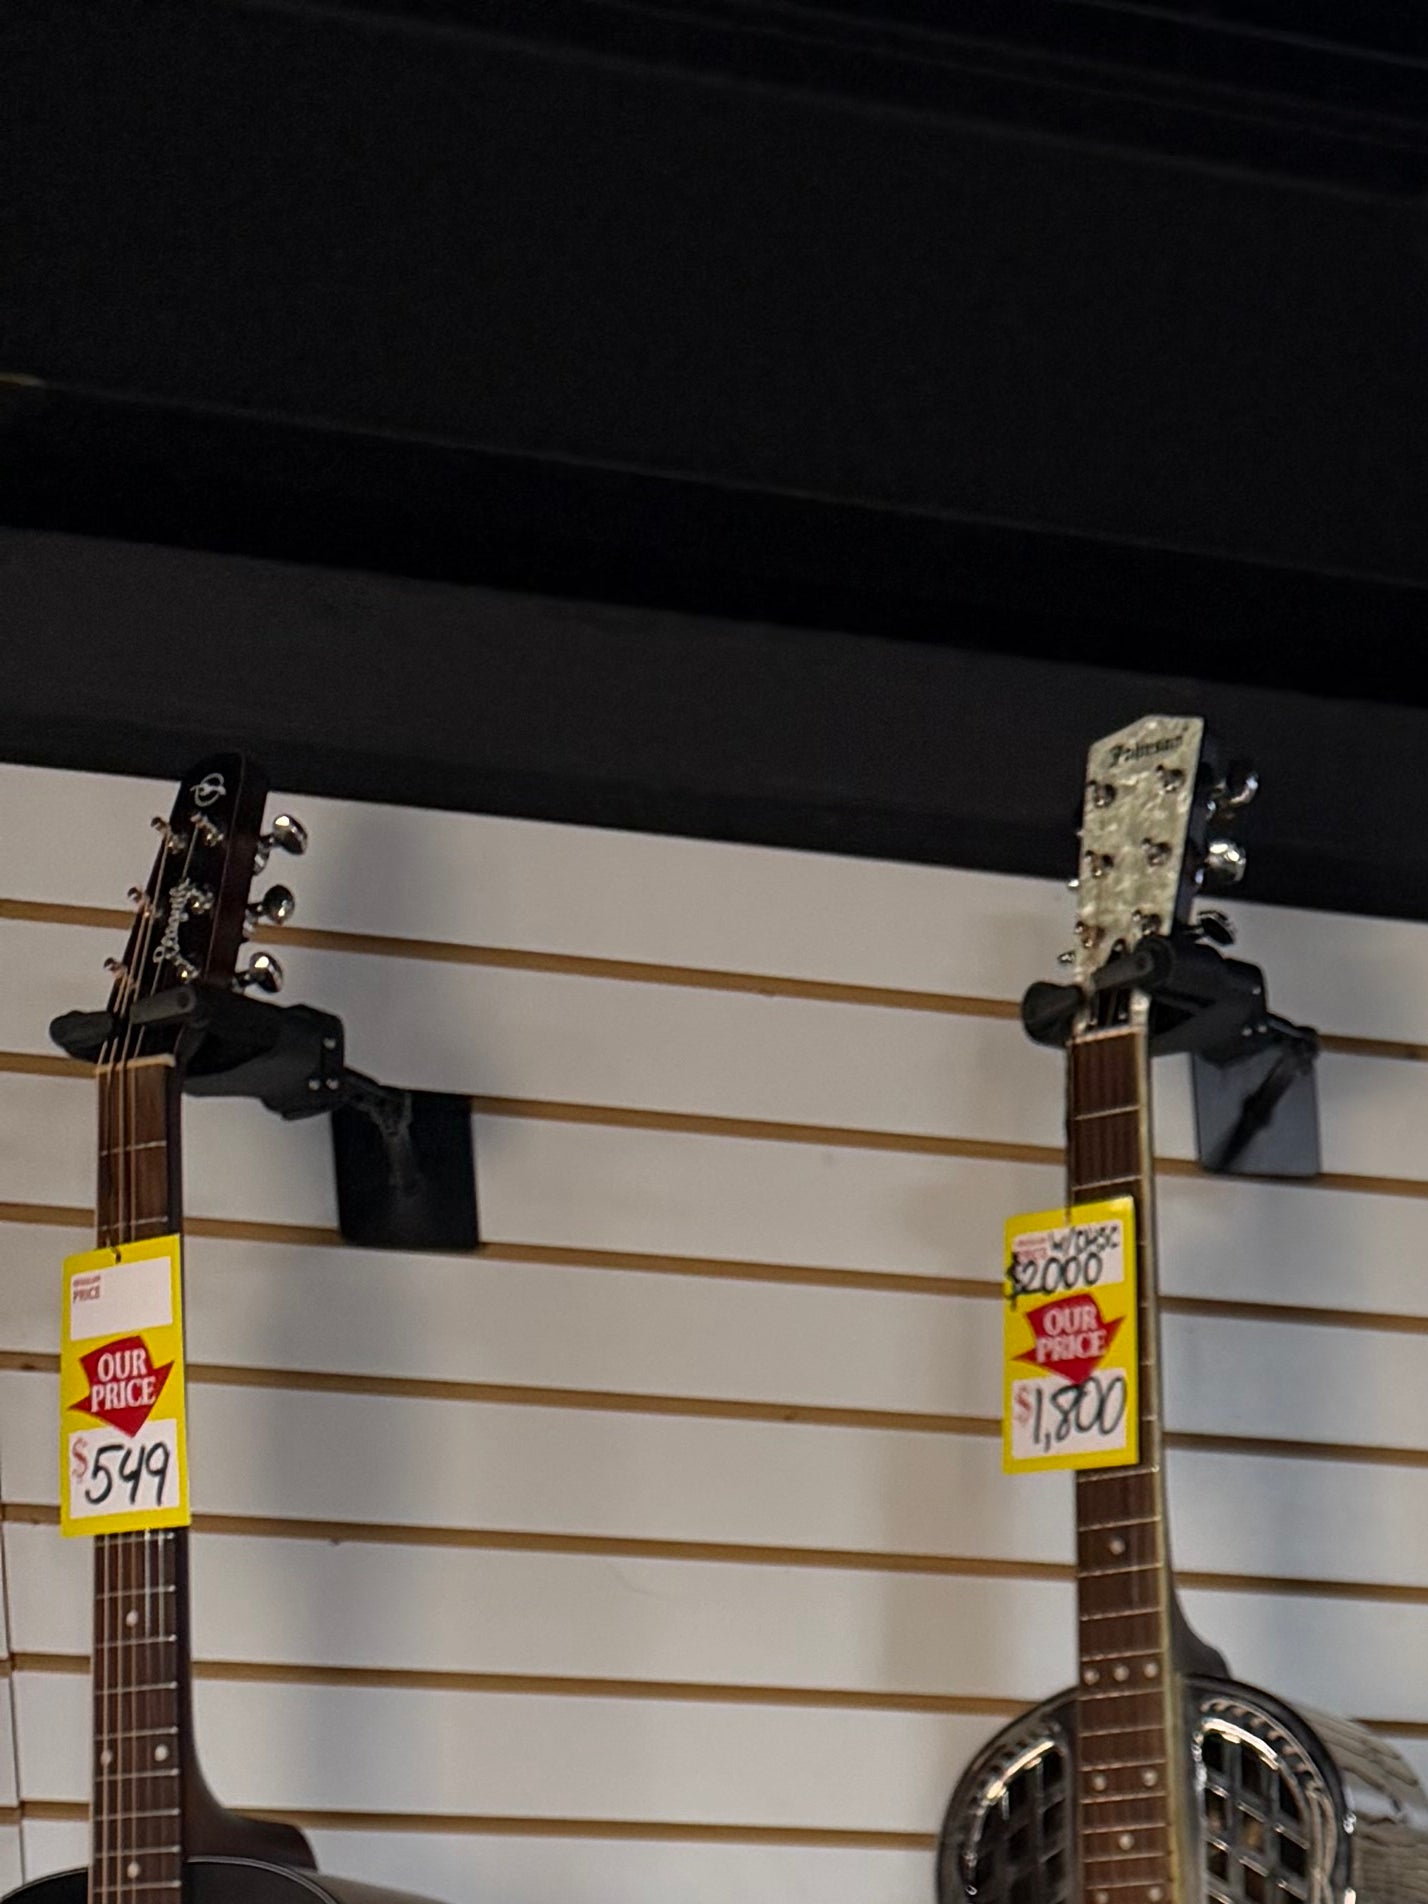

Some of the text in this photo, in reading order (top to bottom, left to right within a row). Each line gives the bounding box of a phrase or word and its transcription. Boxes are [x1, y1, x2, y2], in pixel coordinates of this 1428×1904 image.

[1042, 1305, 1098, 1337] OUR
[1036, 1329, 1108, 1364] PRICE
[97, 1347, 148, 1381] OUR
[90, 1375, 157, 1413] PRICE
